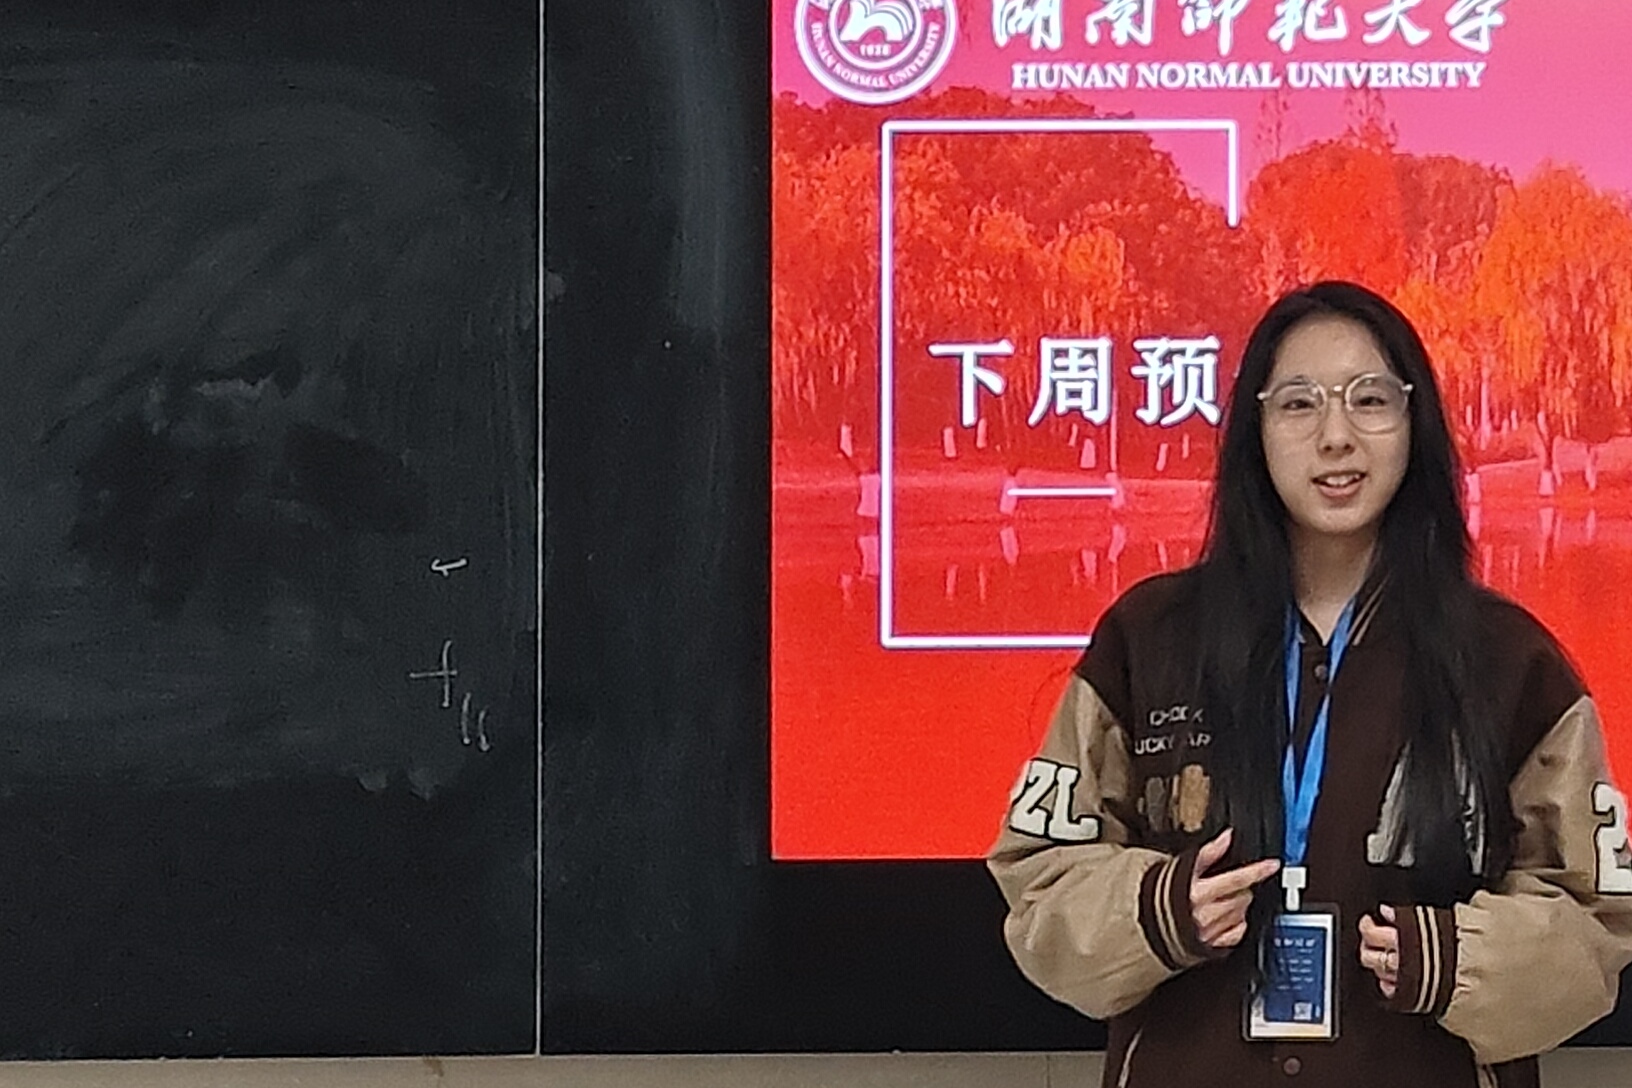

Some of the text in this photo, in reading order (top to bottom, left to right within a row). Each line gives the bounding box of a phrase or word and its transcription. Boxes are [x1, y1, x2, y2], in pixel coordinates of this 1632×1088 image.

[1011, 62, 1487, 88] HUNAN NORMAL UNIVERSITY
[928, 335, 1222, 428] 下周预
